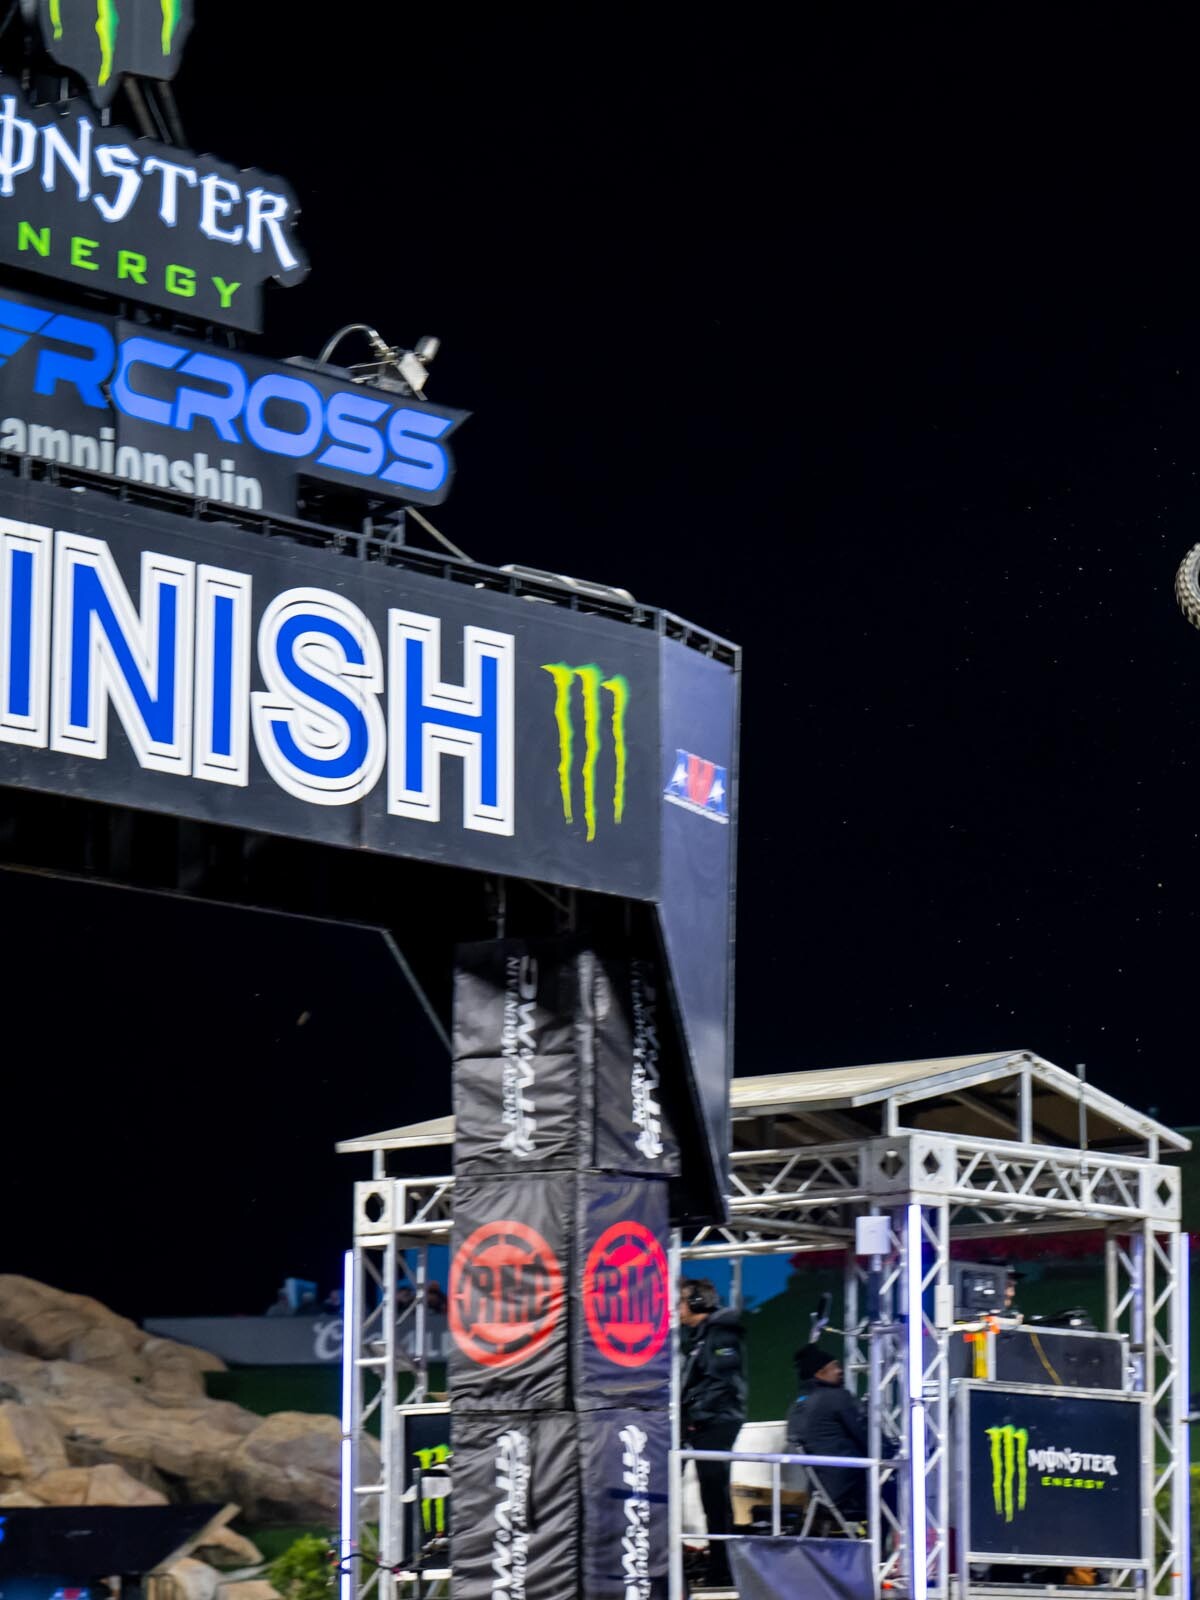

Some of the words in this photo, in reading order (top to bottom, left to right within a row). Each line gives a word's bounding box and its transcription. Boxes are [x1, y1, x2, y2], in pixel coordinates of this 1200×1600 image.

[17, 221, 241, 308] NERGY
[0, 519, 514, 836] INISH
[501, 956, 520, 1058] MOUNTAIN
[502, 1063, 517, 1125] ROCKY
[631, 1062, 648, 1125] ROCKY
[1027, 1446, 1118, 1475] MONSTER
[1041, 1476, 1105, 1489] ENERGY
[511, 1463, 531, 1526] ROCKY
